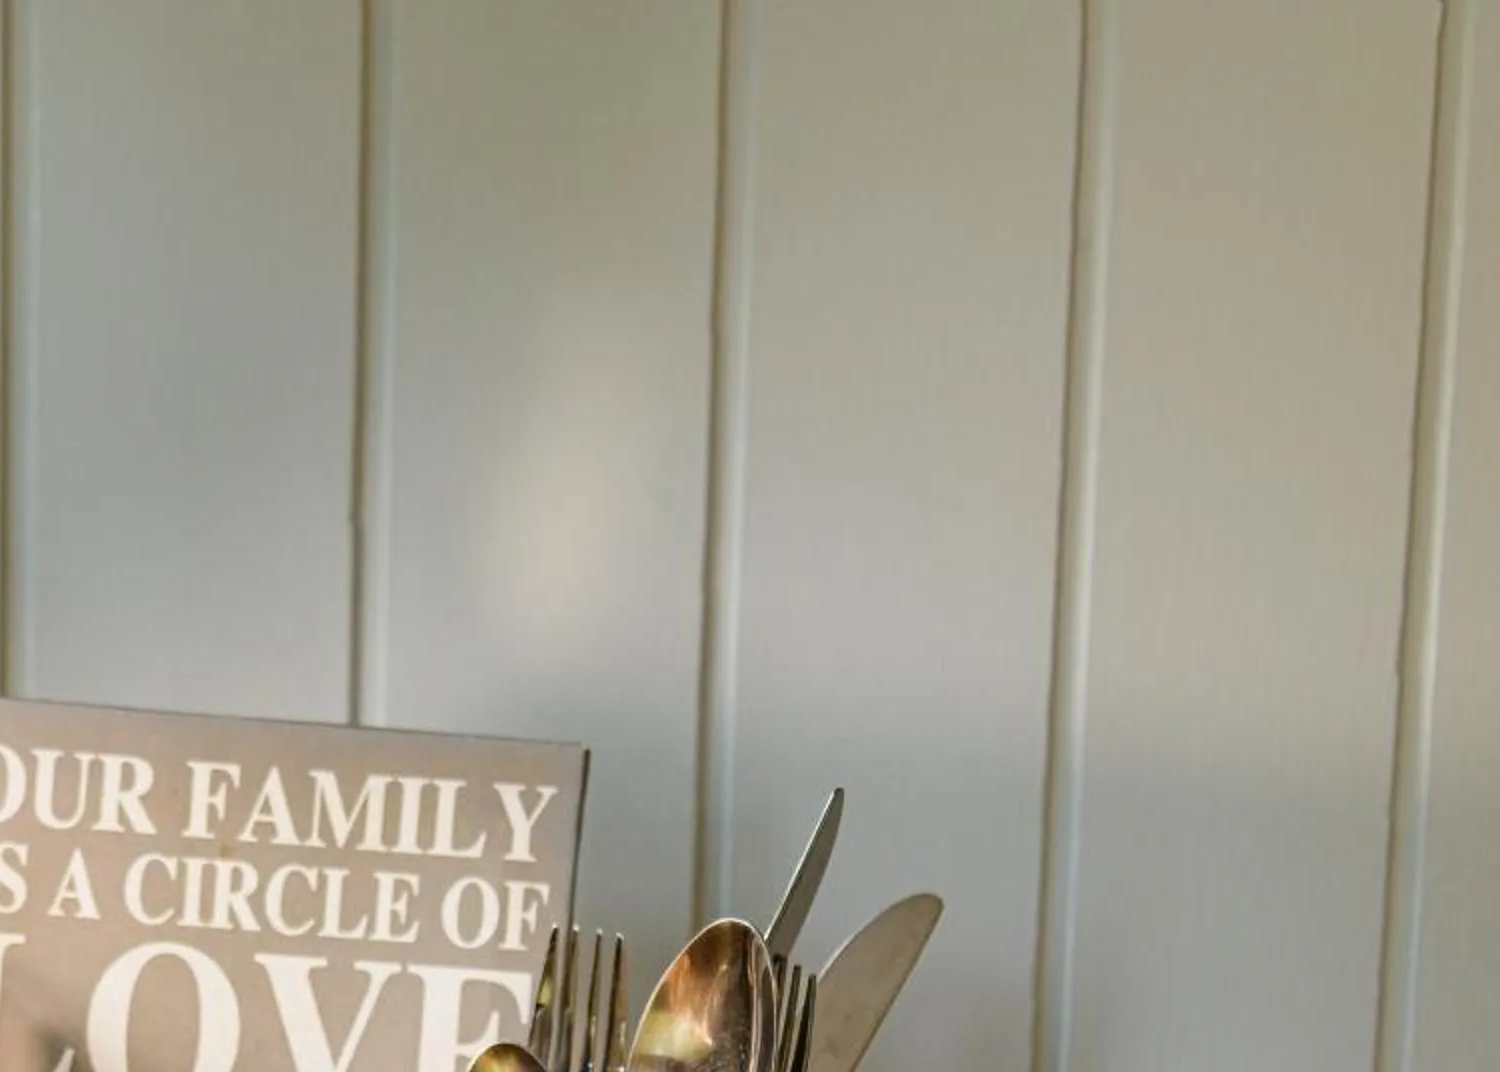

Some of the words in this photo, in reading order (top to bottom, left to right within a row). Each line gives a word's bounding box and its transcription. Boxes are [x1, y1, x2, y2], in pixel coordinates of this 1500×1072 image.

[182, 761, 557, 861] FAMILY
[48, 848, 100, 920] A
[124, 853, 419, 943] CIRCLE
[441, 876, 550, 951] OF
